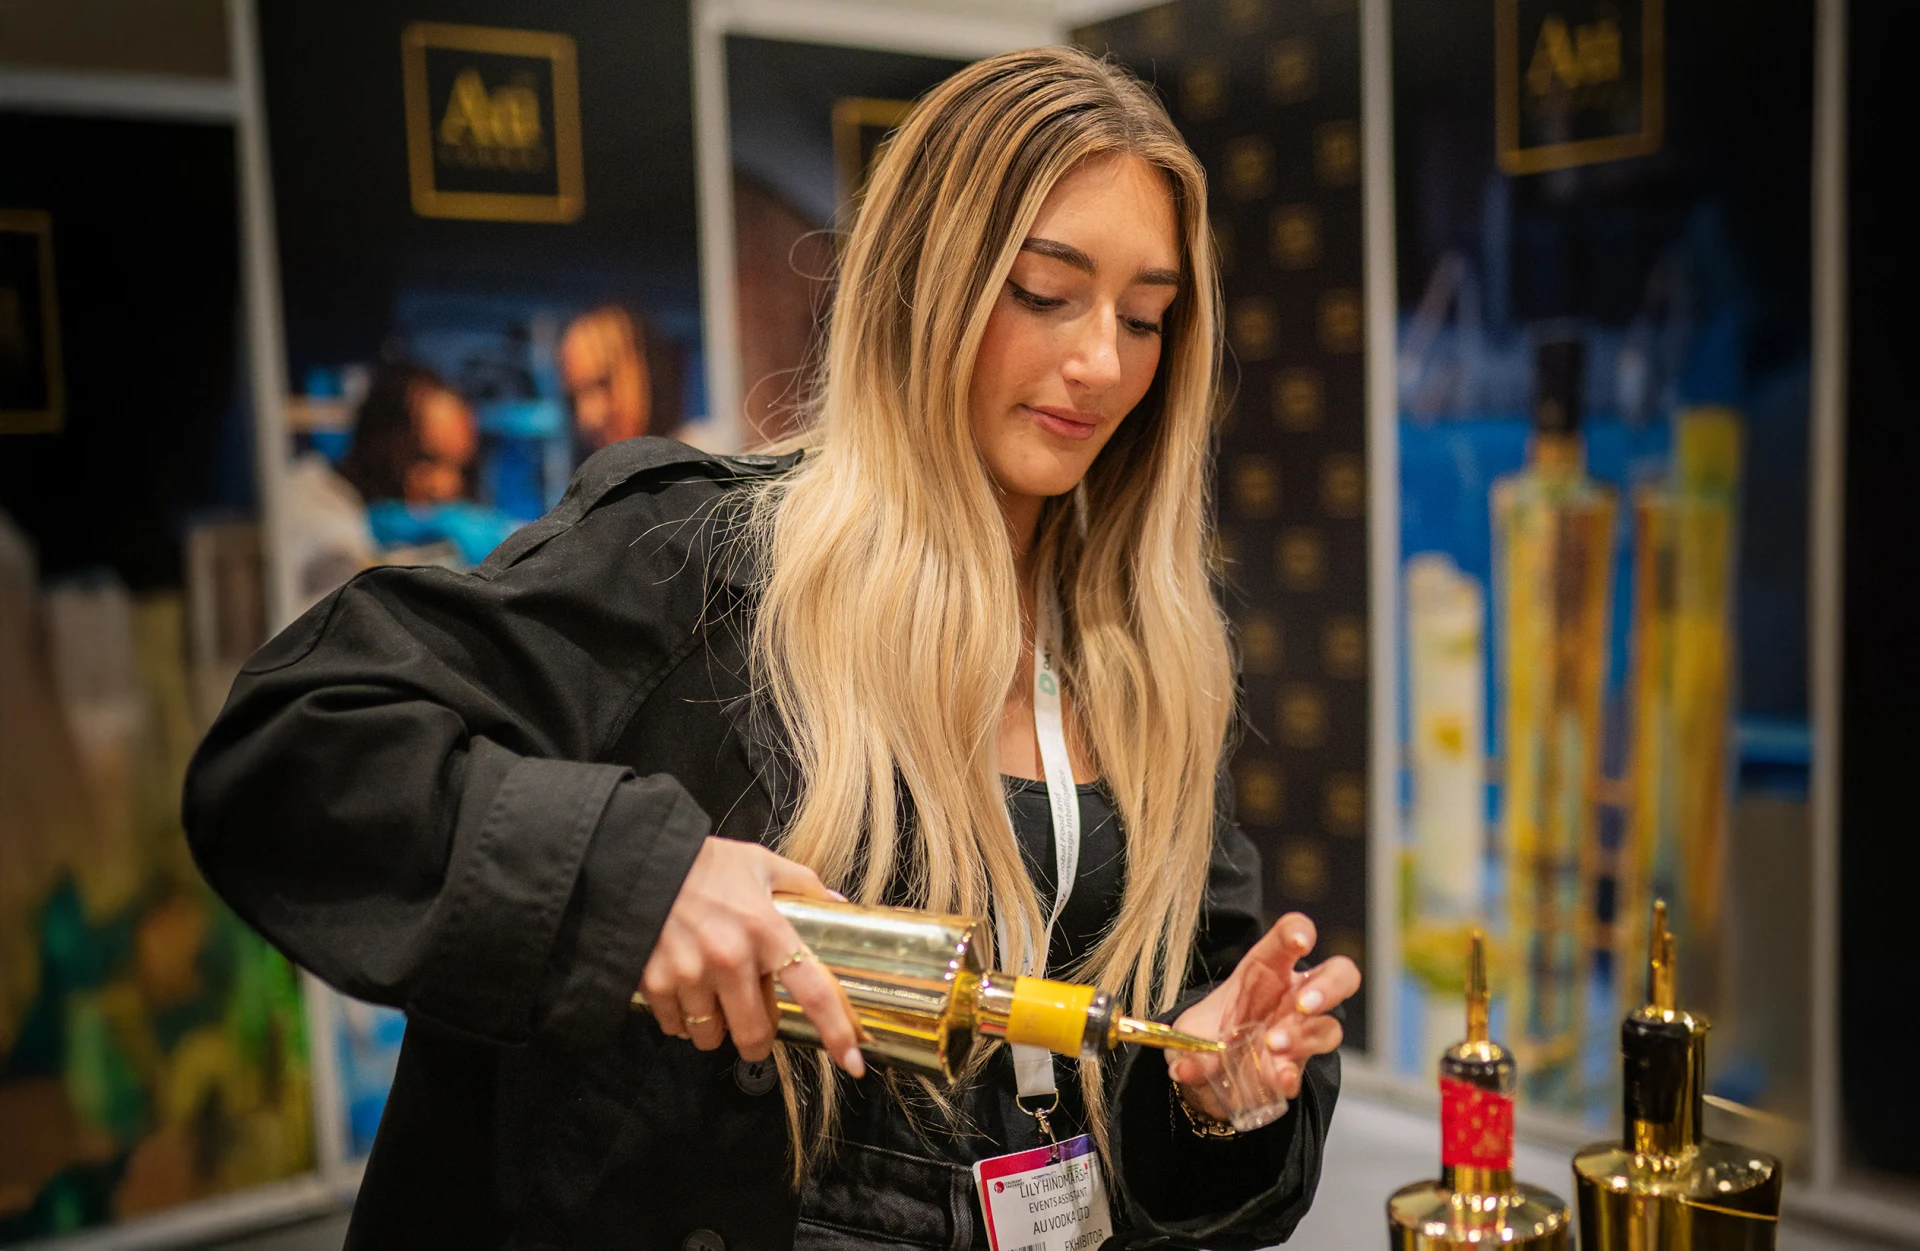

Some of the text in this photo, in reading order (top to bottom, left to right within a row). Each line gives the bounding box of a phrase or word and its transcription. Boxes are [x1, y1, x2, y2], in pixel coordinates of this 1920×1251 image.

[1053, 791, 1064, 813] and
[1059, 769, 1073, 827] Intelligence
[1019, 1168, 1089, 1198] LILY HINDMARSH
[1029, 1187, 1088, 1213] EVENTS ASSISTANT
[1033, 1206, 1090, 1235] AU VODKA LTD
[1064, 1228, 1105, 1251] EXHIBITOR
